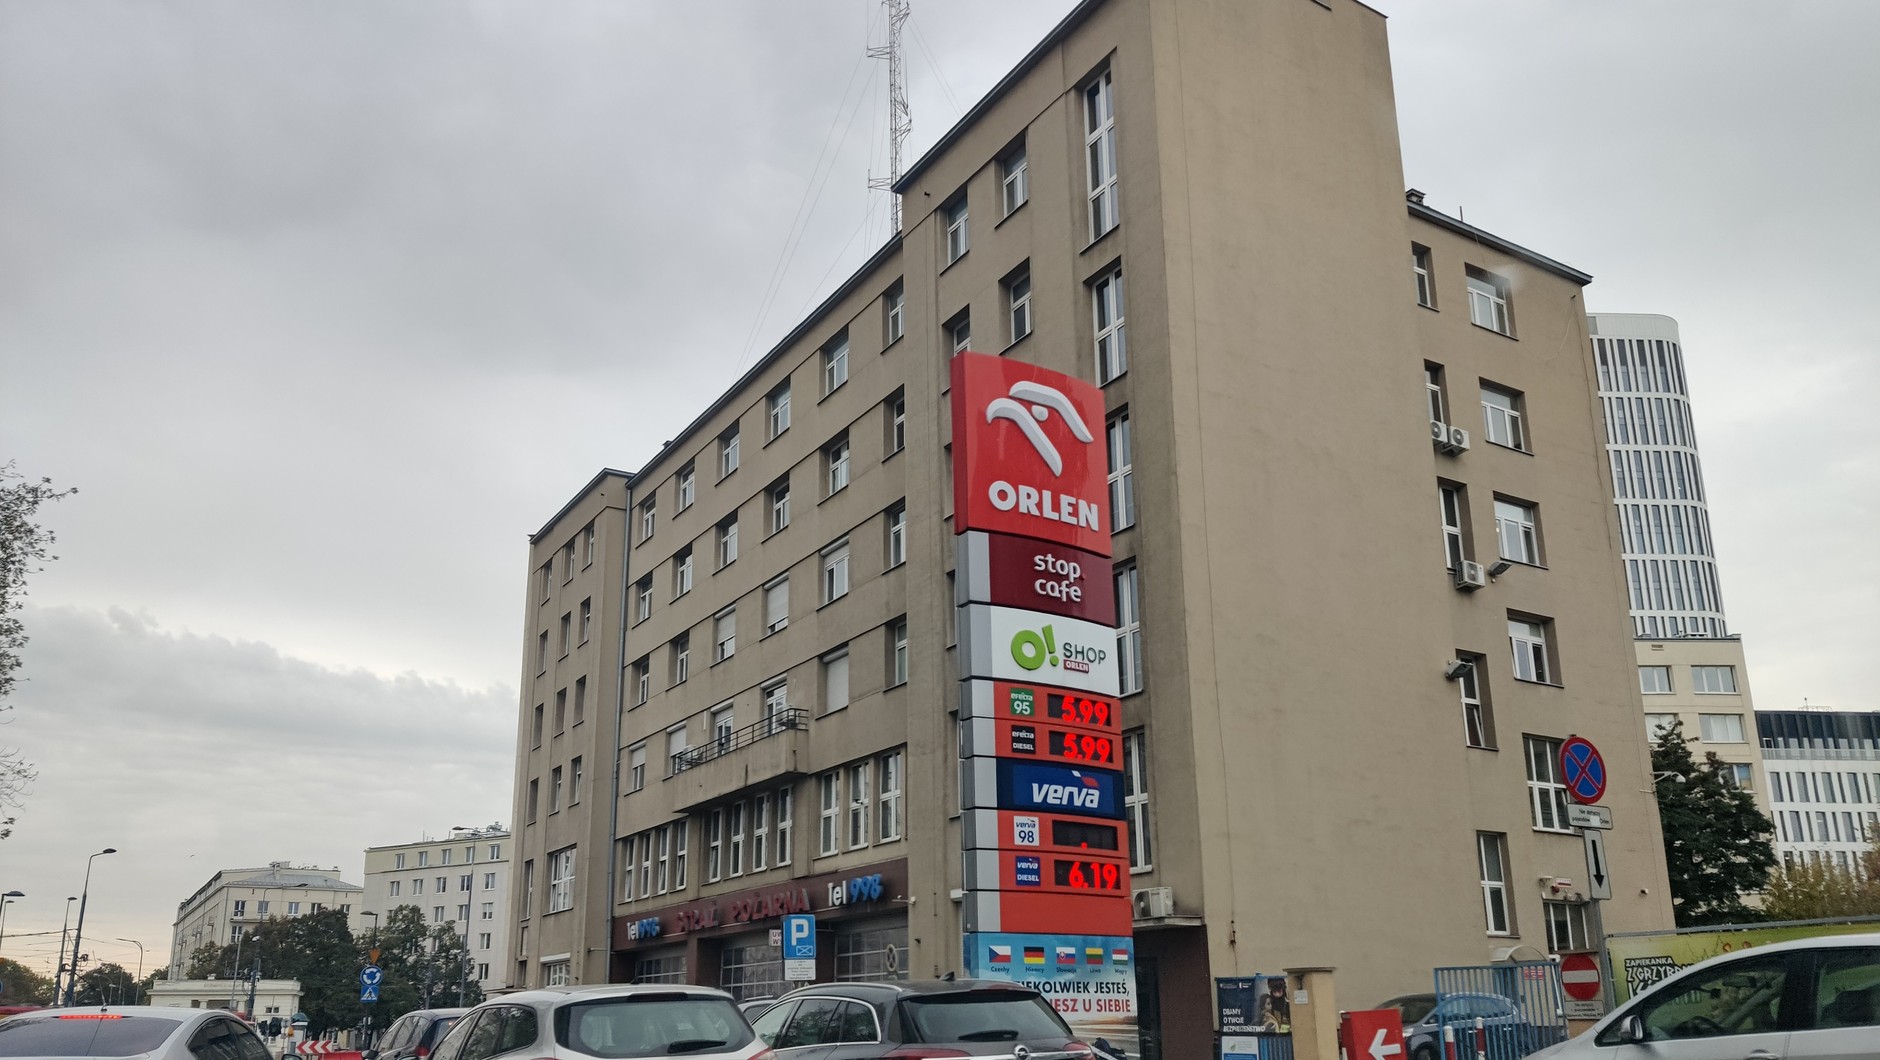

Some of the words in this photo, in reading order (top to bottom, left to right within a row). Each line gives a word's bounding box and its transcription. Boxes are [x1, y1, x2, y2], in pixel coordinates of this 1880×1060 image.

[989, 481, 1098, 531] ORLEN
[1034, 554, 1080, 582] stop
[1035, 579, 1081, 602] cafe
[1011, 624, 1059, 671] O!
[1063, 642, 1106, 664] SHOP
[1065, 660, 1089, 672] ORLEN
[1014, 701, 1030, 715] 95
[1062, 695, 1109, 727] 5.99
[1063, 733, 1110, 763] 5.99
[1032, 783, 1100, 808] verva
[1018, 830, 1034, 843] 98
[1017, 861, 1038, 869] verva
[1017, 874, 1039, 882] DIESEL
[1069, 861, 1117, 890] 6.19
[828, 880, 846, 907] Tel
[851, 874, 883, 903] 998
[731, 888, 811, 922] POŻARNA
[627, 921, 639, 940] Tel
[791, 919, 809, 946] P
[991, 966, 1010, 974] Czechy
[1026, 966, 1044, 974] Niemcy
[1625, 957, 1673, 967] ZAPIEKANKA
[1093, 979, 1129, 996] JESTEŚ,
[1083, 999, 1091, 1012] U
[1096, 999, 1131, 1013] SIEBIE
